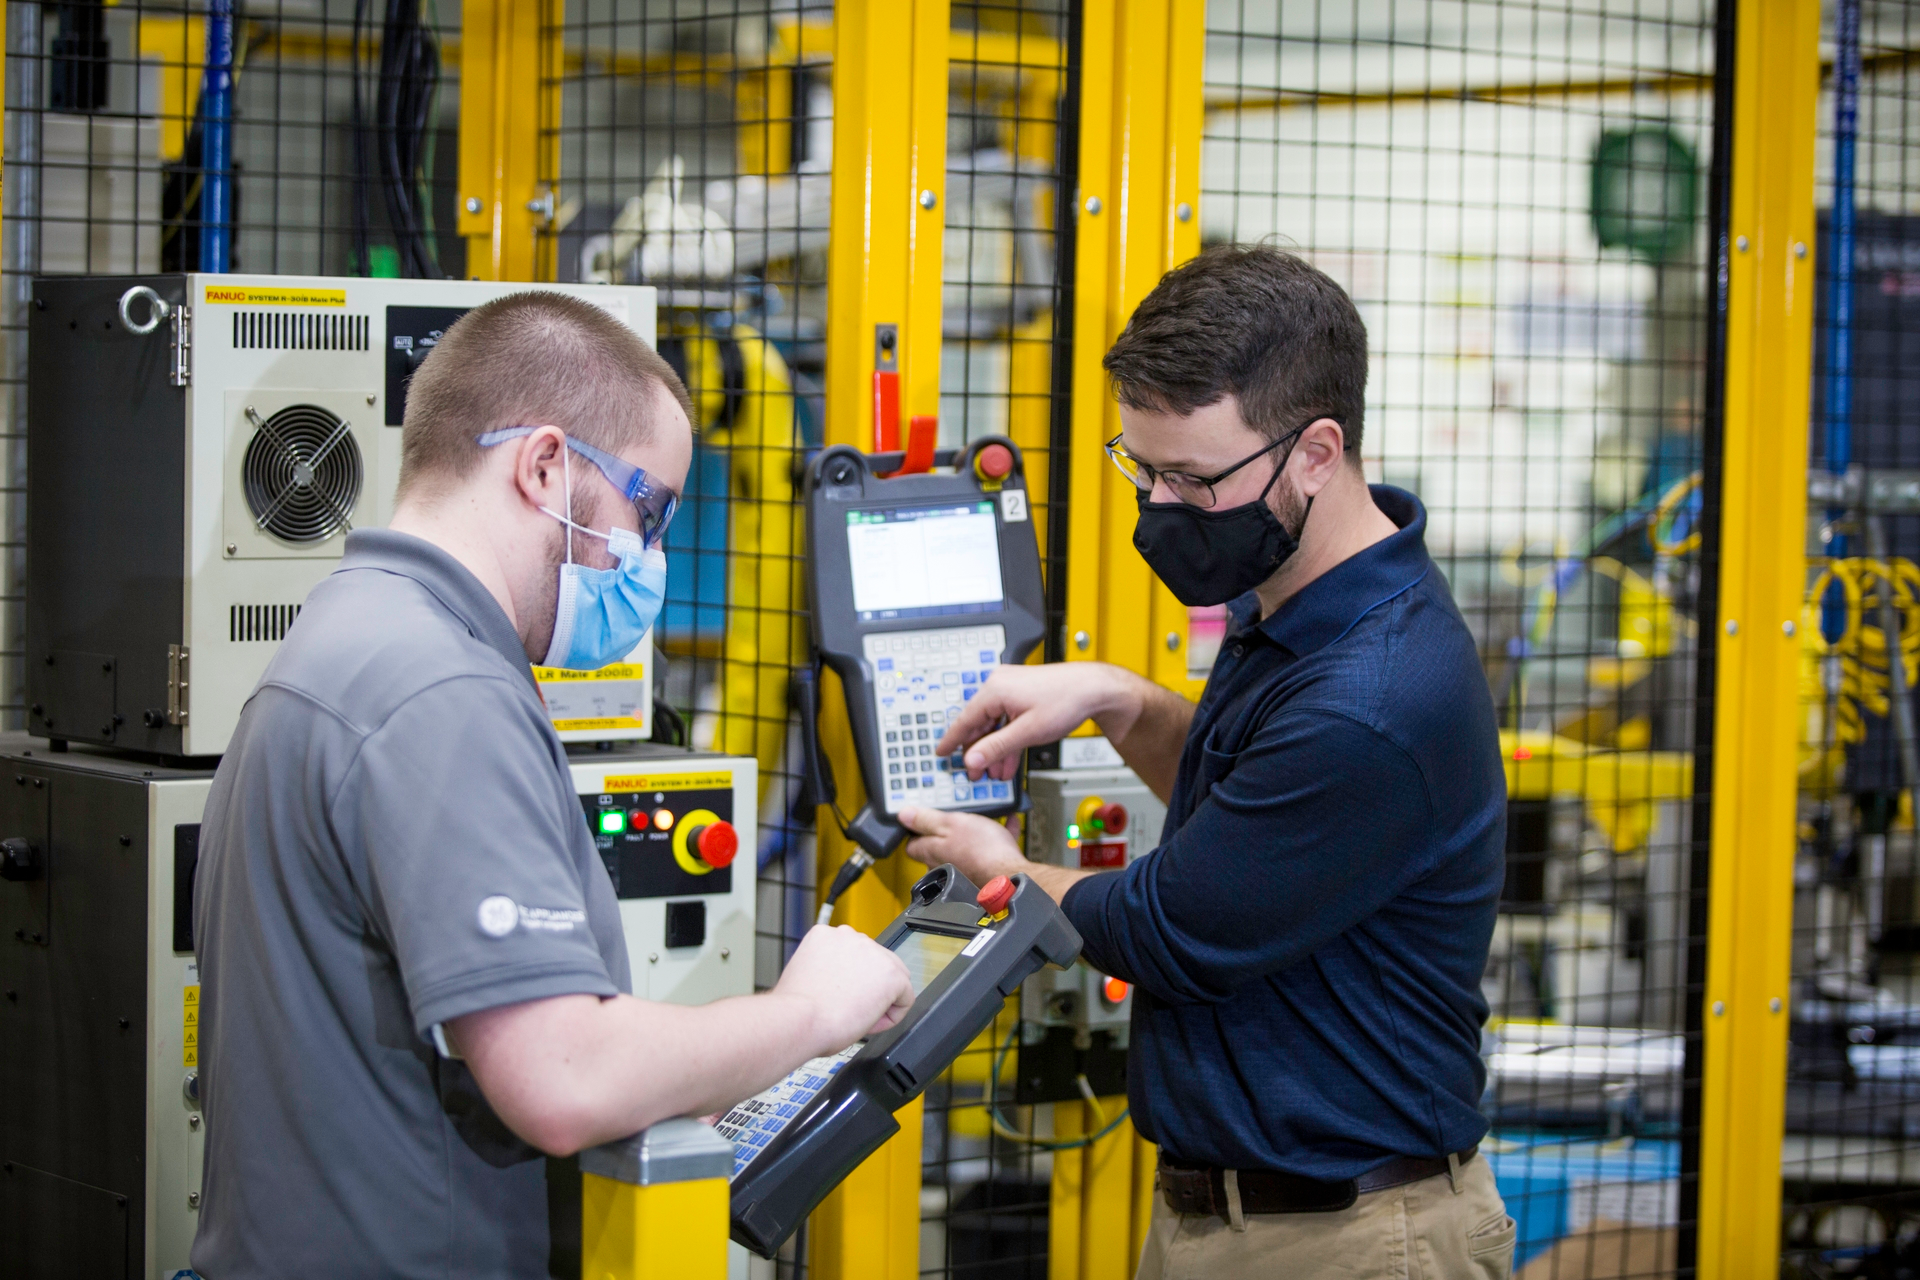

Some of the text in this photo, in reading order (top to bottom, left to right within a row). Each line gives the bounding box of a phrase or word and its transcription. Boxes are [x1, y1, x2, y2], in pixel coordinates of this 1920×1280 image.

[207, 291, 245, 301] FANUC
[248, 294, 279, 302] SYSTEM
[1007, 496, 1021, 516] 2
[606, 778, 648, 789] FANUC
